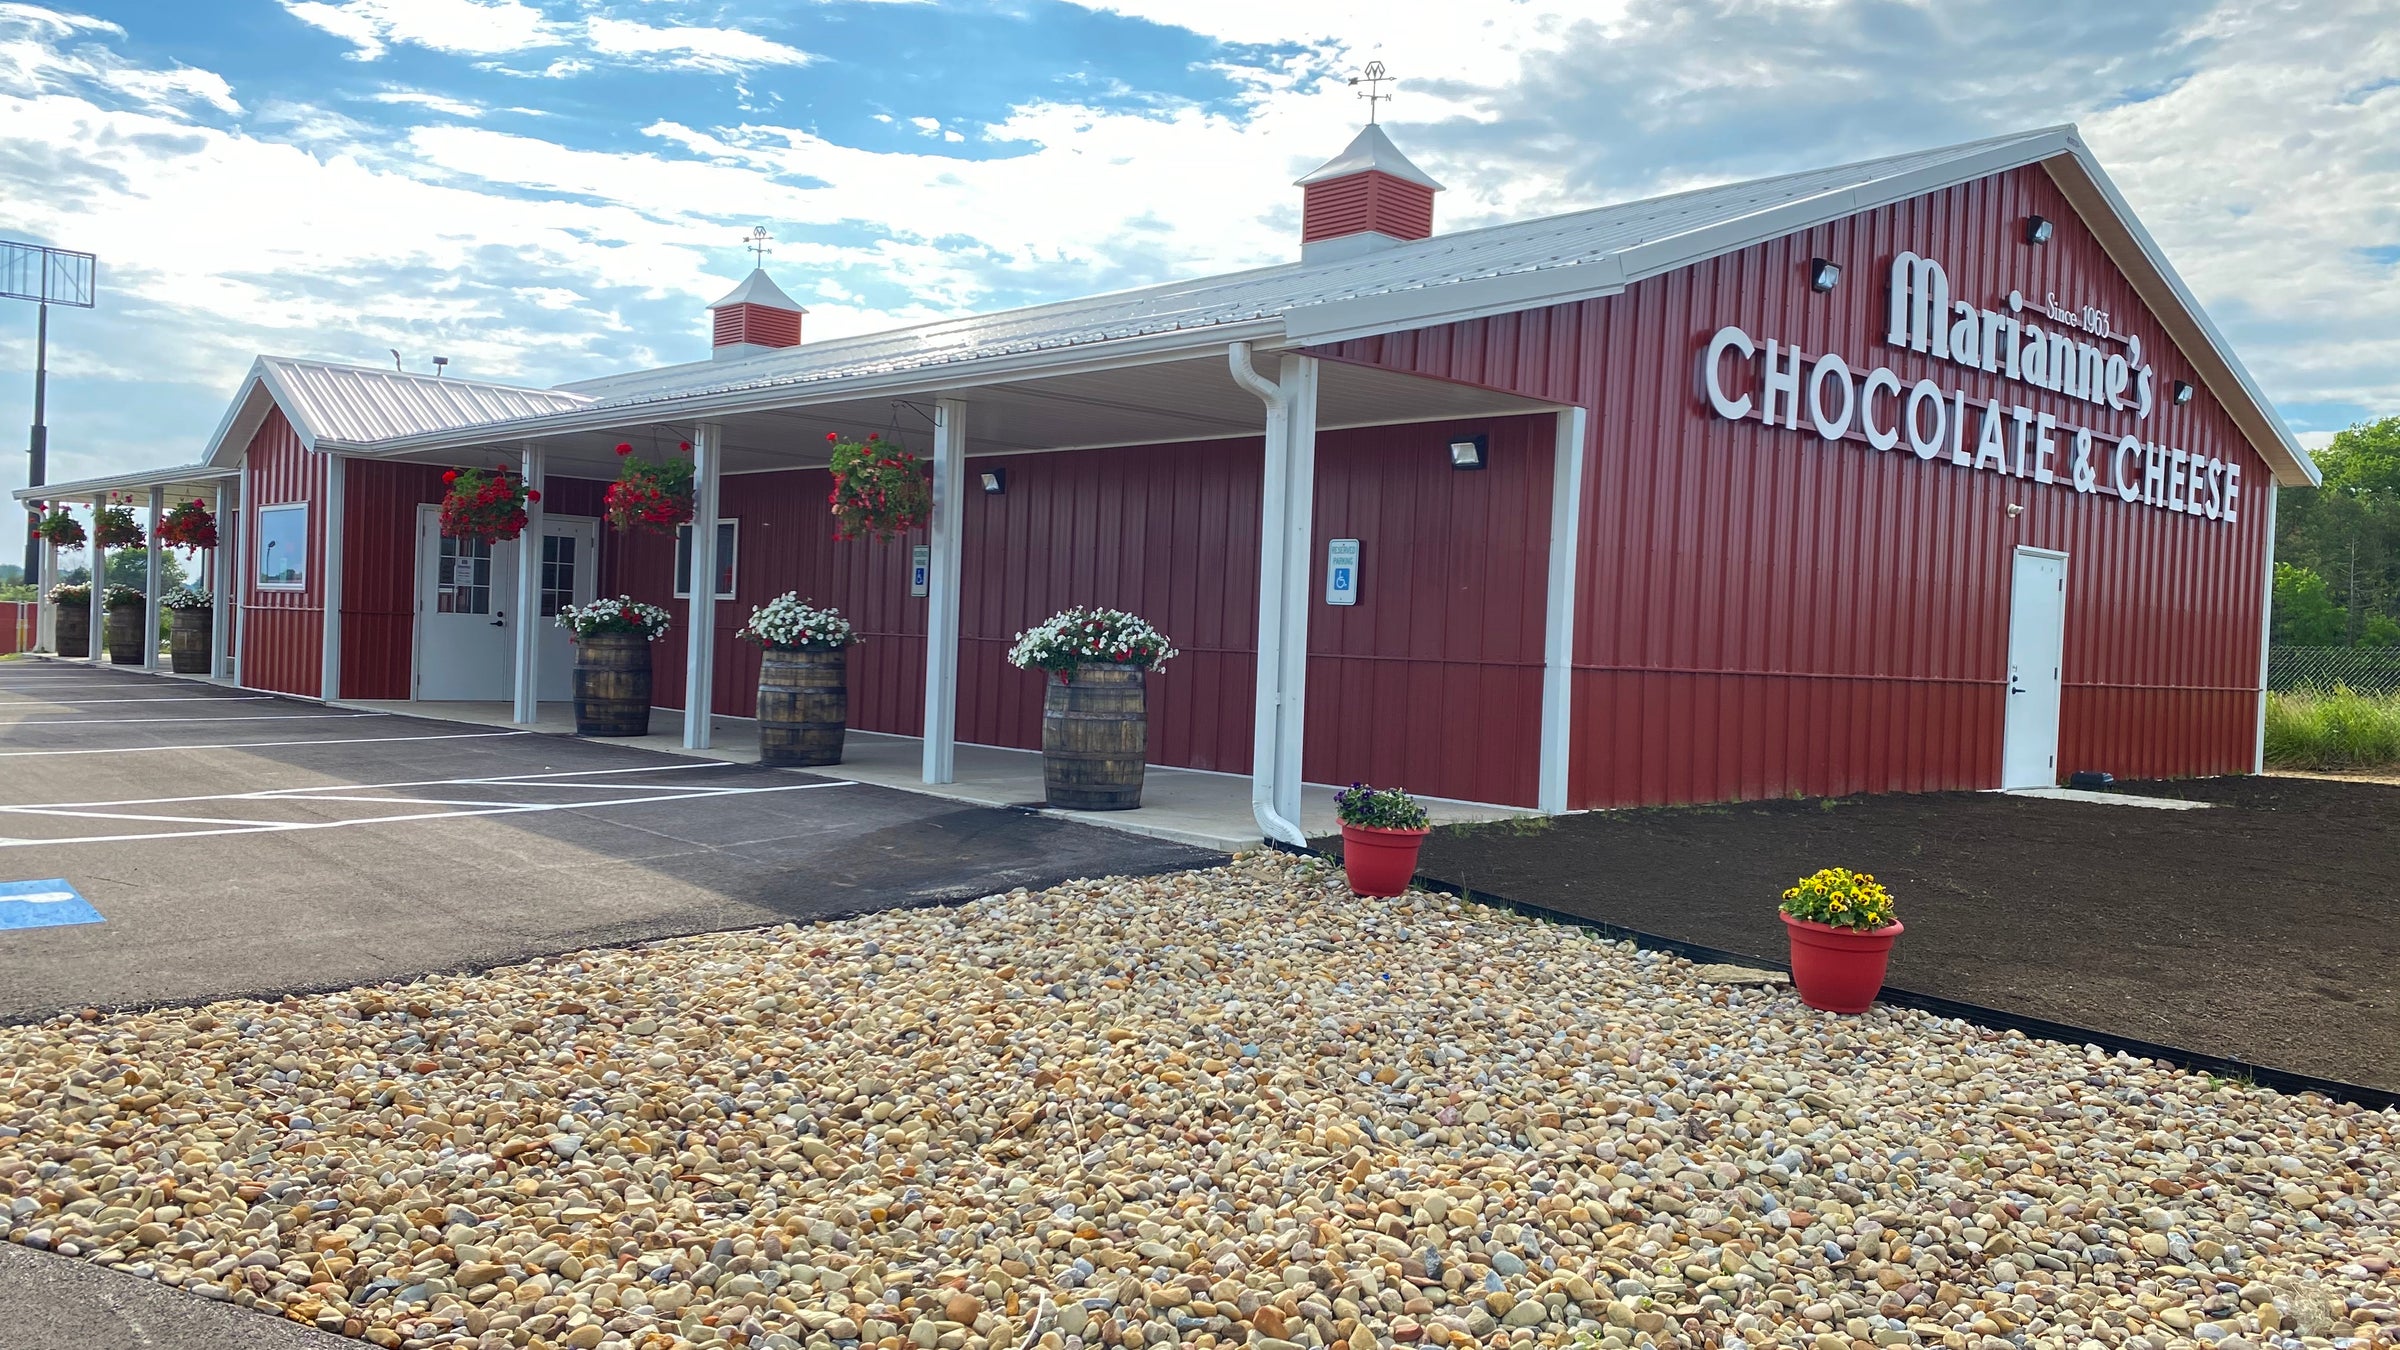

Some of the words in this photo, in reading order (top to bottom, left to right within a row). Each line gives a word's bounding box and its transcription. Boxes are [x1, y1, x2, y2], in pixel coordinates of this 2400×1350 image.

[1887, 251, 2153, 420] Marianne's
[2046, 292, 2077, 328] Since
[2081, 304, 2110, 339] 1963
[1706, 326, 2056, 485] CHOCOLATE
[2073, 427, 2096, 494] &
[2115, 435, 2240, 523] CHEESE
